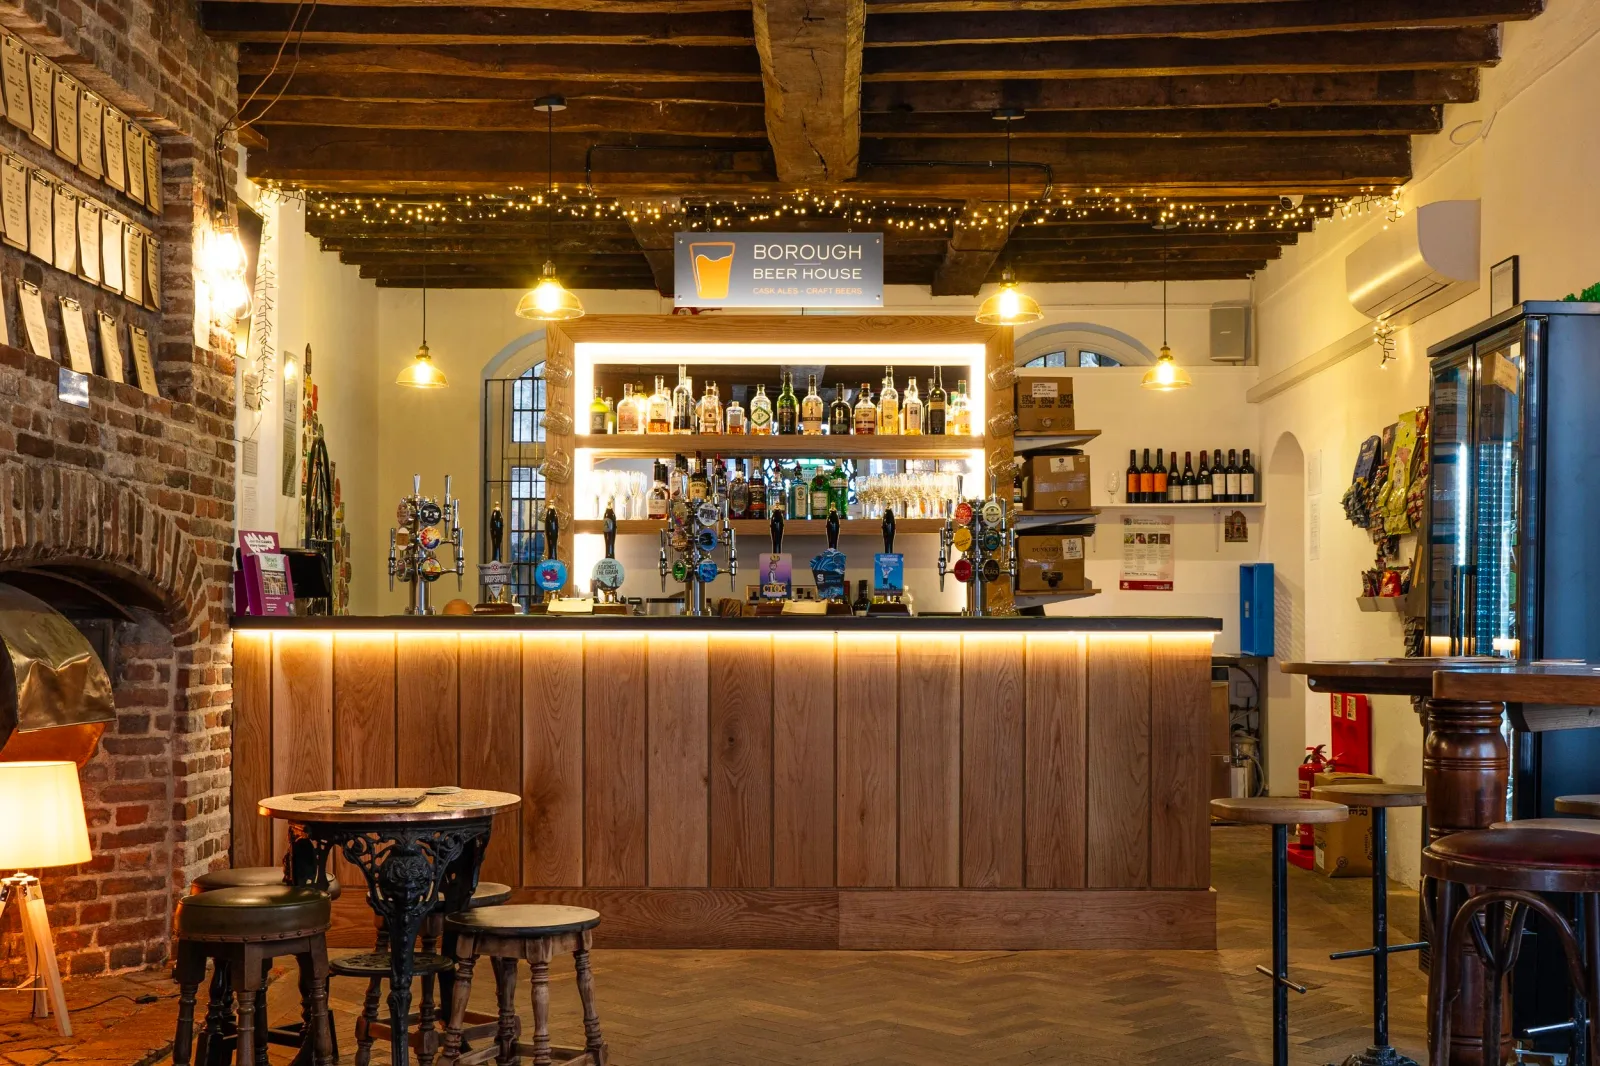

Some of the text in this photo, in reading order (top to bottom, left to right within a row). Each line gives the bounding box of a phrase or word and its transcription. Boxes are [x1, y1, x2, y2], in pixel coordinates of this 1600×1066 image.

[753, 244, 862, 260] BOROUGH
[753, 268, 862, 280] BEER HOUSE
[753, 287, 775, 295] CASK
[777, 287, 798, 295] ALES
[807, 287, 833, 295] CRAFT
[835, 287, 862, 295] BEERS
[484, 574, 507, 583] HOPSPUR
